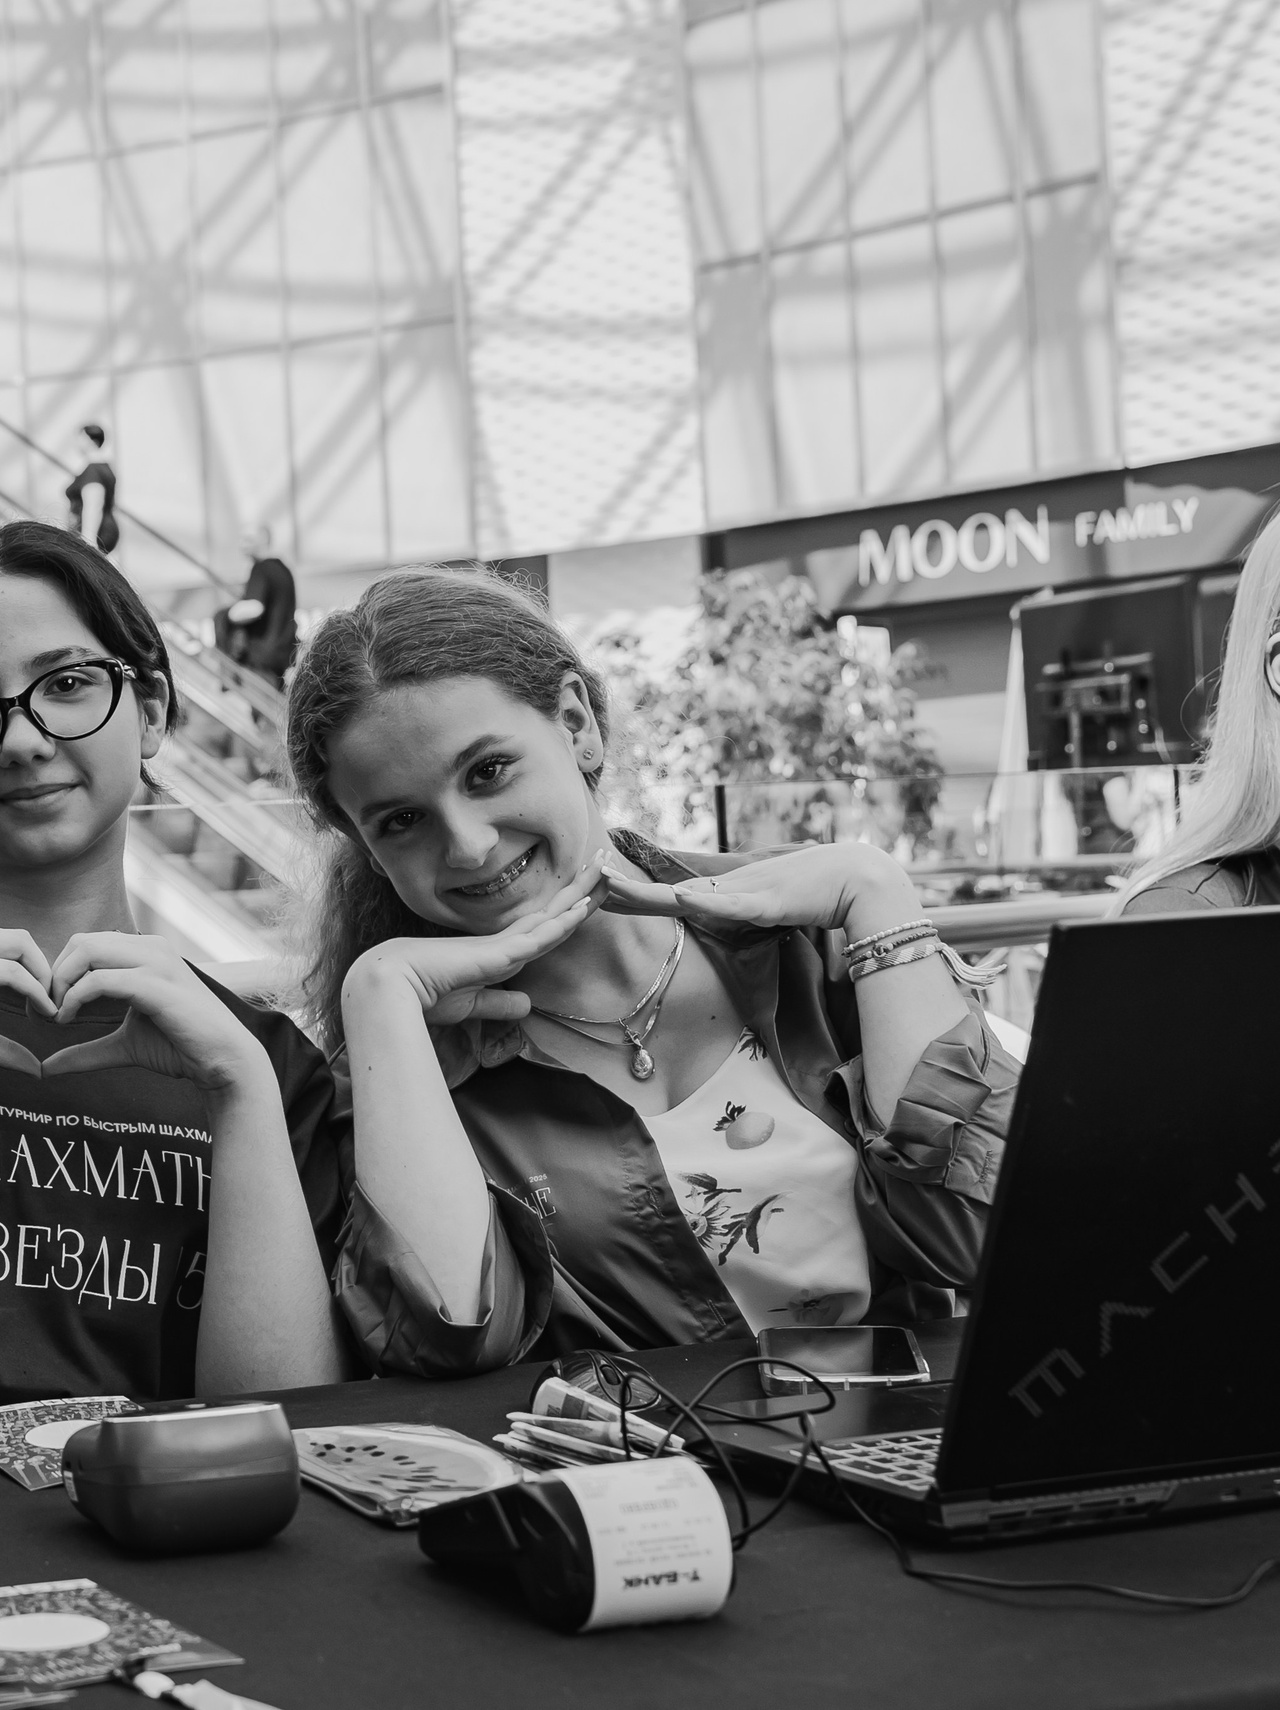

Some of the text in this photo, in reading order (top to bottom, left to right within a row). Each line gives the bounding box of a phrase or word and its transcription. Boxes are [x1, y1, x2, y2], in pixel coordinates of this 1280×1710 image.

[858, 497, 1200, 587] MOON FAMILY
[56, 1115, 80, 1126] ПО
[83, 1115, 156, 1134] БЫСТРЫМ
